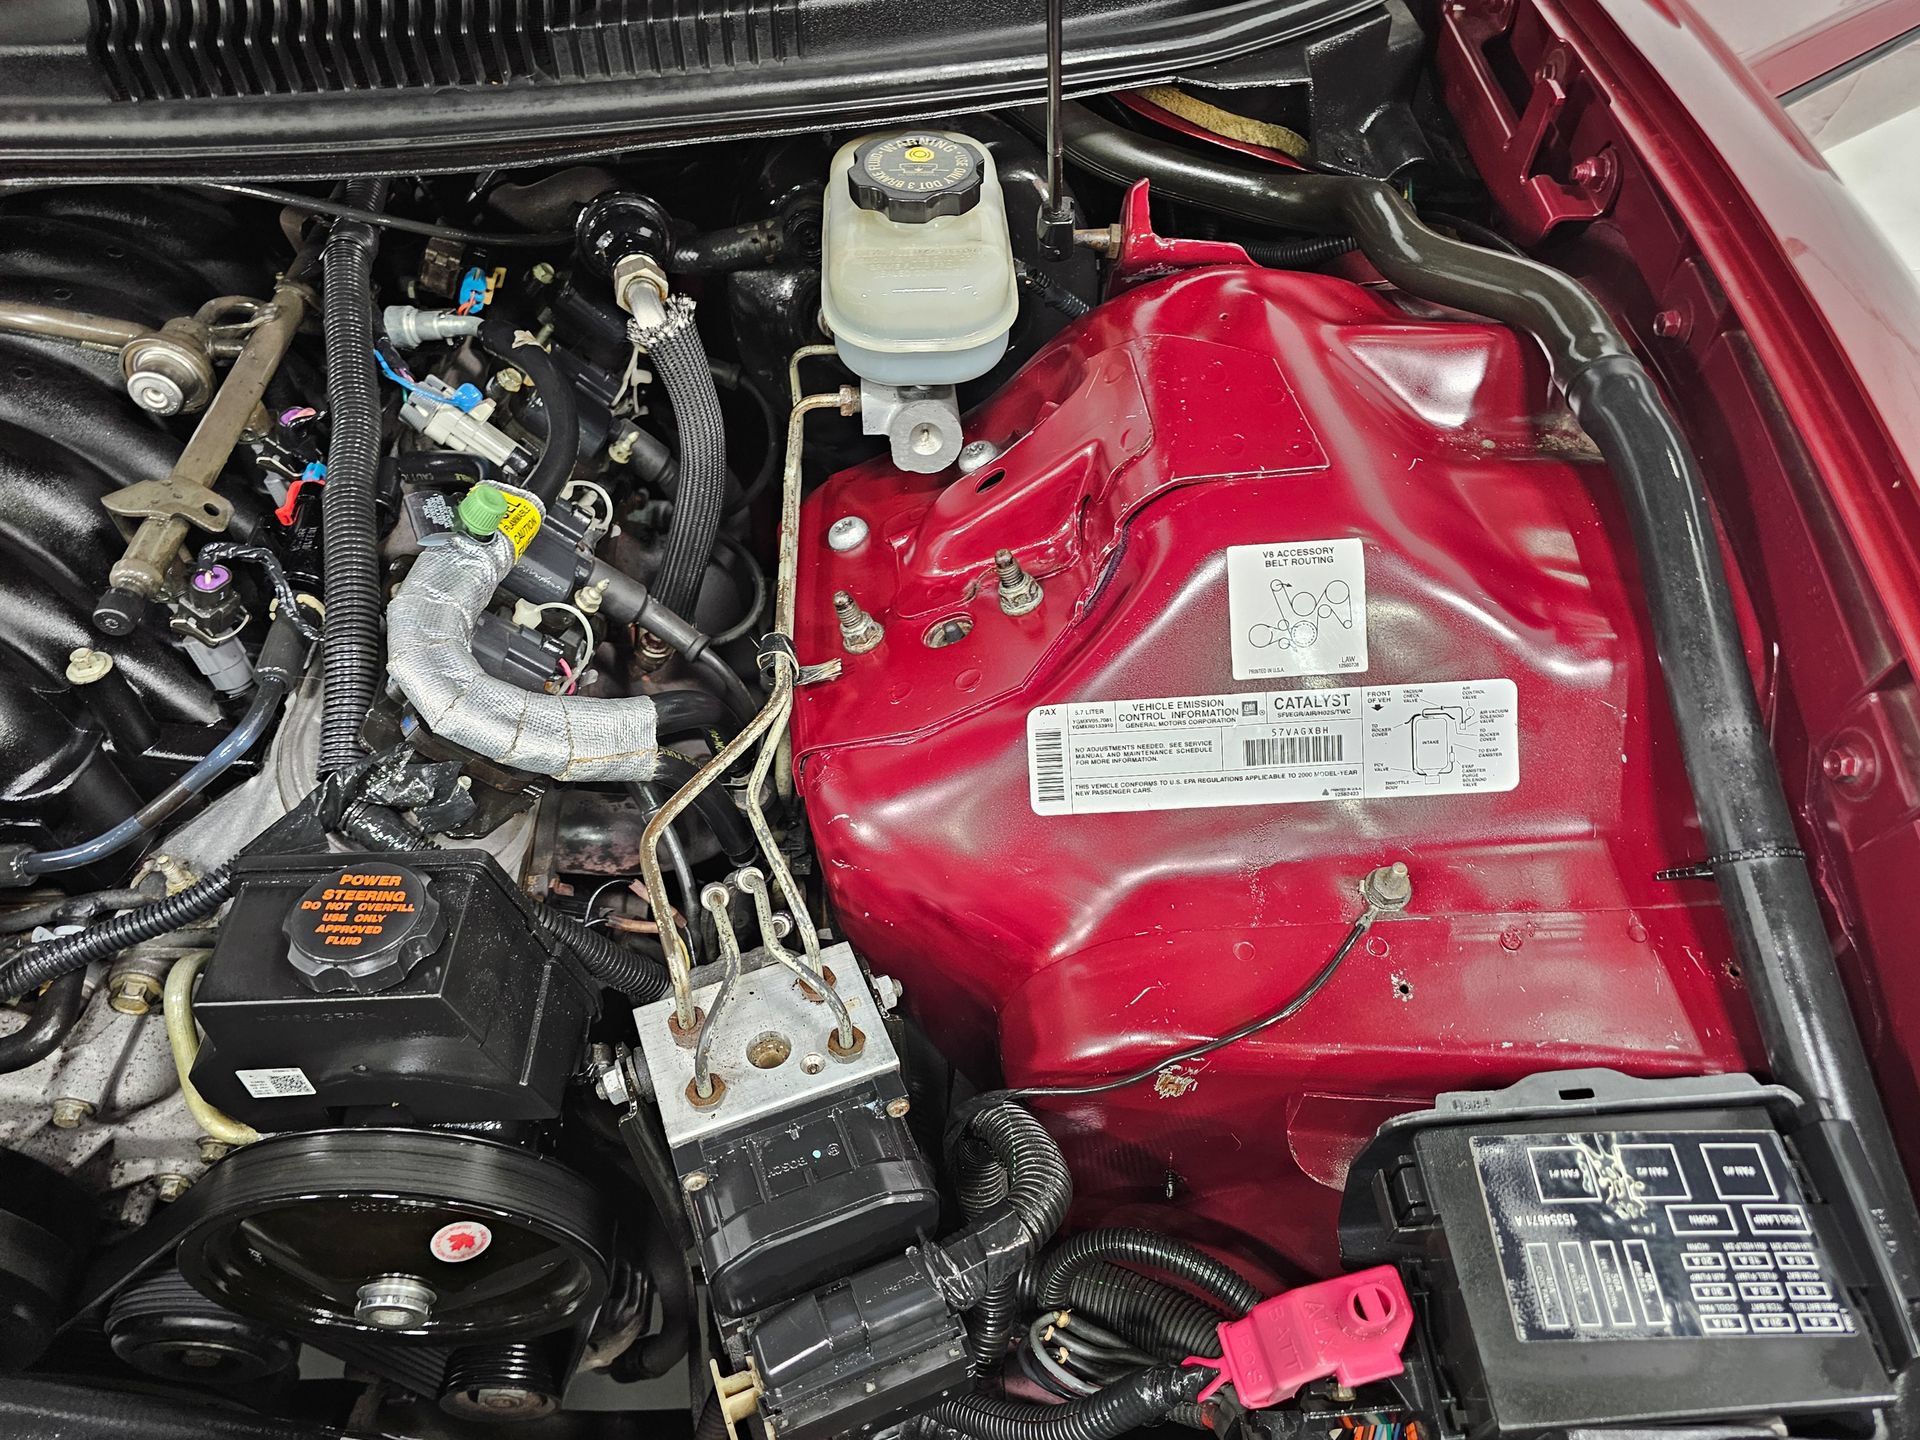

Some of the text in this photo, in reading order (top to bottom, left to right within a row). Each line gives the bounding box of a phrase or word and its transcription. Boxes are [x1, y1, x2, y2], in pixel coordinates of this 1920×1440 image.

[883, 137, 957, 153] WARNING
[868, 152, 883, 171] FLUID
[872, 171, 904, 188] BRAKE
[944, 168, 966, 184] ONLY
[920, 180, 943, 190] DOT
[1262, 546, 1335, 560] V8 ACCESSORY
[1265, 555, 1334, 568] BELT ROUTING
[1367, 690, 1391, 698] FRONT
[1132, 699, 1225, 712] VEHICLE EMISSION
[1274, 693, 1351, 710] CATALYST
[1039, 708, 1057, 717] PAX
[1118, 708, 1239, 722] CONTROL INFORMATION
[1188, 717, 1237, 726] CORPORATION
[1086, 744, 1135, 752] ADJUSTMENTS
[1123, 749, 1173, 757] MAINTENANCE
[1198, 776, 1244, 784] REGULATIONS
[1245, 773, 1286, 781] APPLICABLE
[340, 874, 402, 886] POWER
[322, 889, 407, 902] STEERING
[301, 901, 415, 913] DO NOT OVERFILL
[322, 913, 386, 923] USE ONLY
[315, 924, 383, 935] APPROVED
[325, 936, 362, 946] FLUID
[1565, 1168, 1580, 1179] FAN
[1650, 1167, 1669, 1178] FAN
[1735, 1166, 1756, 1178] FAN
[1514, 1215, 1522, 1227] A
[1688, 1214, 1719, 1226] HORN
[1753, 1214, 1802, 1226] FOG LAMP
[1304, 1301, 1336, 1354] AUX
[1268, 1305, 1305, 1371] BATT
[1241, 1335, 1263, 1385] POS
